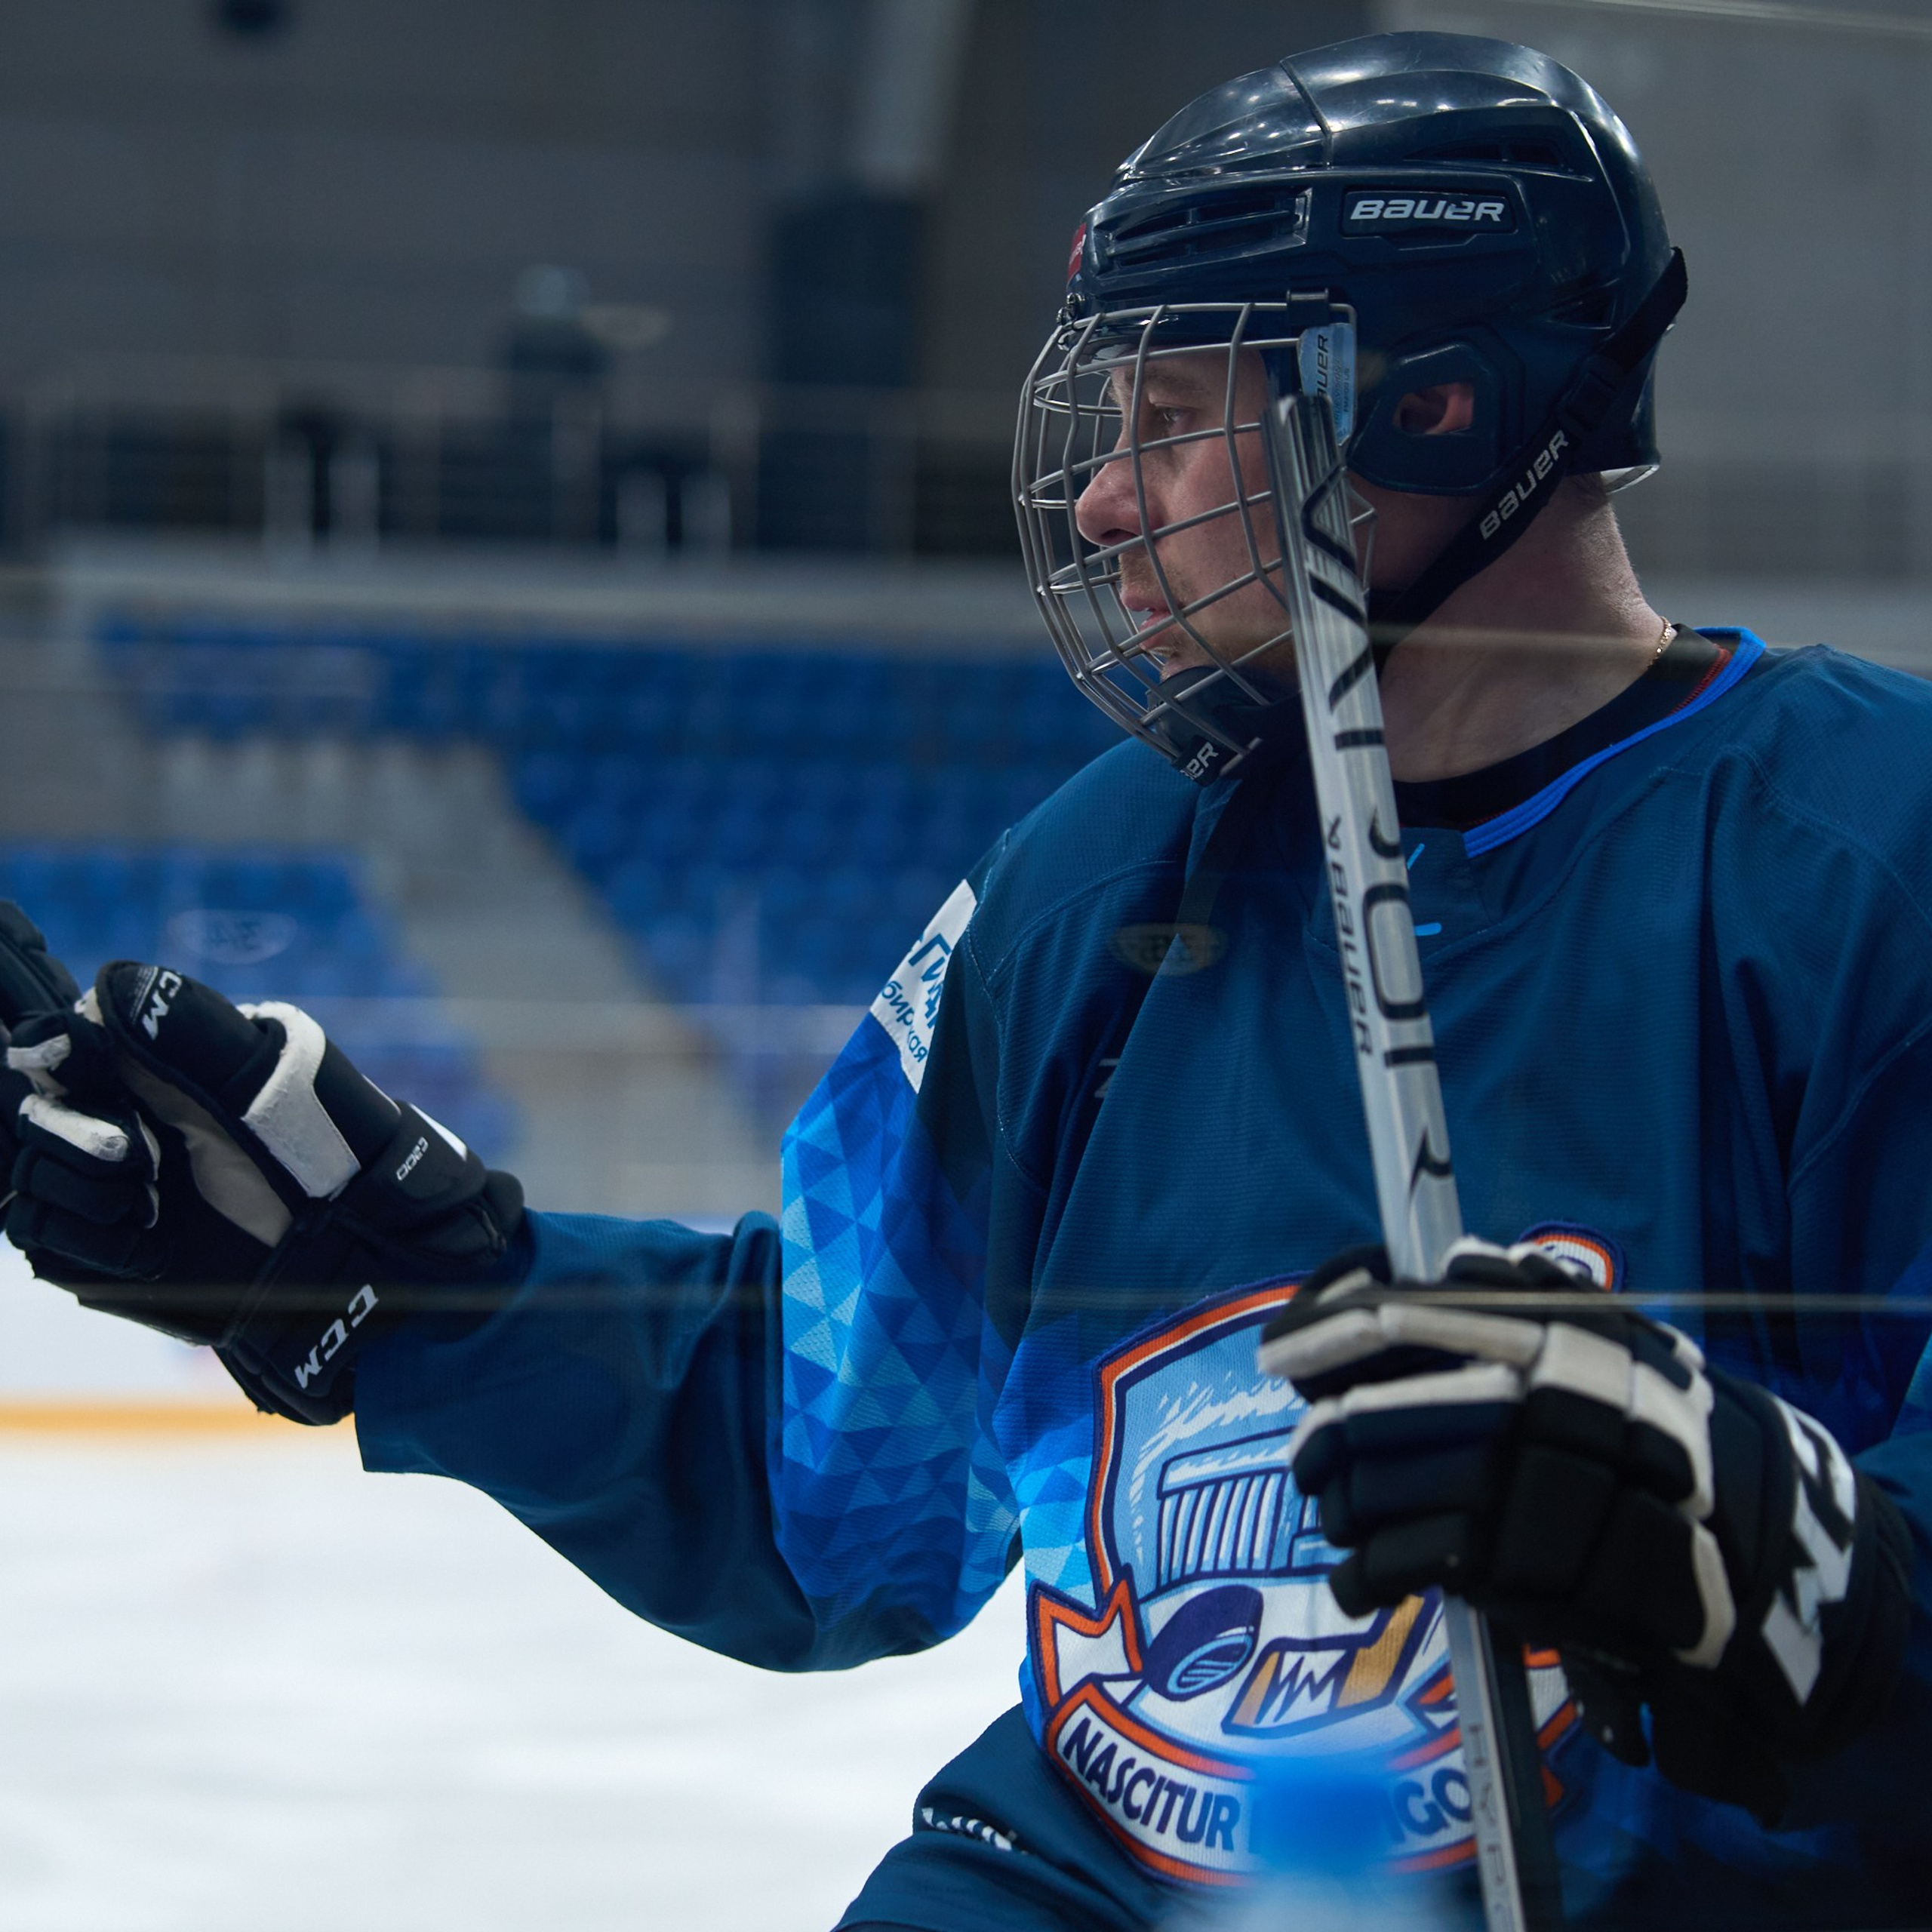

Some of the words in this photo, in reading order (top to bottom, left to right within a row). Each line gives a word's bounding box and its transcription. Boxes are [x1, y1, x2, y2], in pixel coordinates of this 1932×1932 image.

[1350, 199, 1504, 222] BAUER
[1479, 429, 1569, 540] BAUER
[141, 971, 182, 1041] CM
[1331, 863, 1372, 1056] BAUER
[294, 1284, 379, 1389] CCM
[1063, 1717, 1241, 1852] NASCITUR
